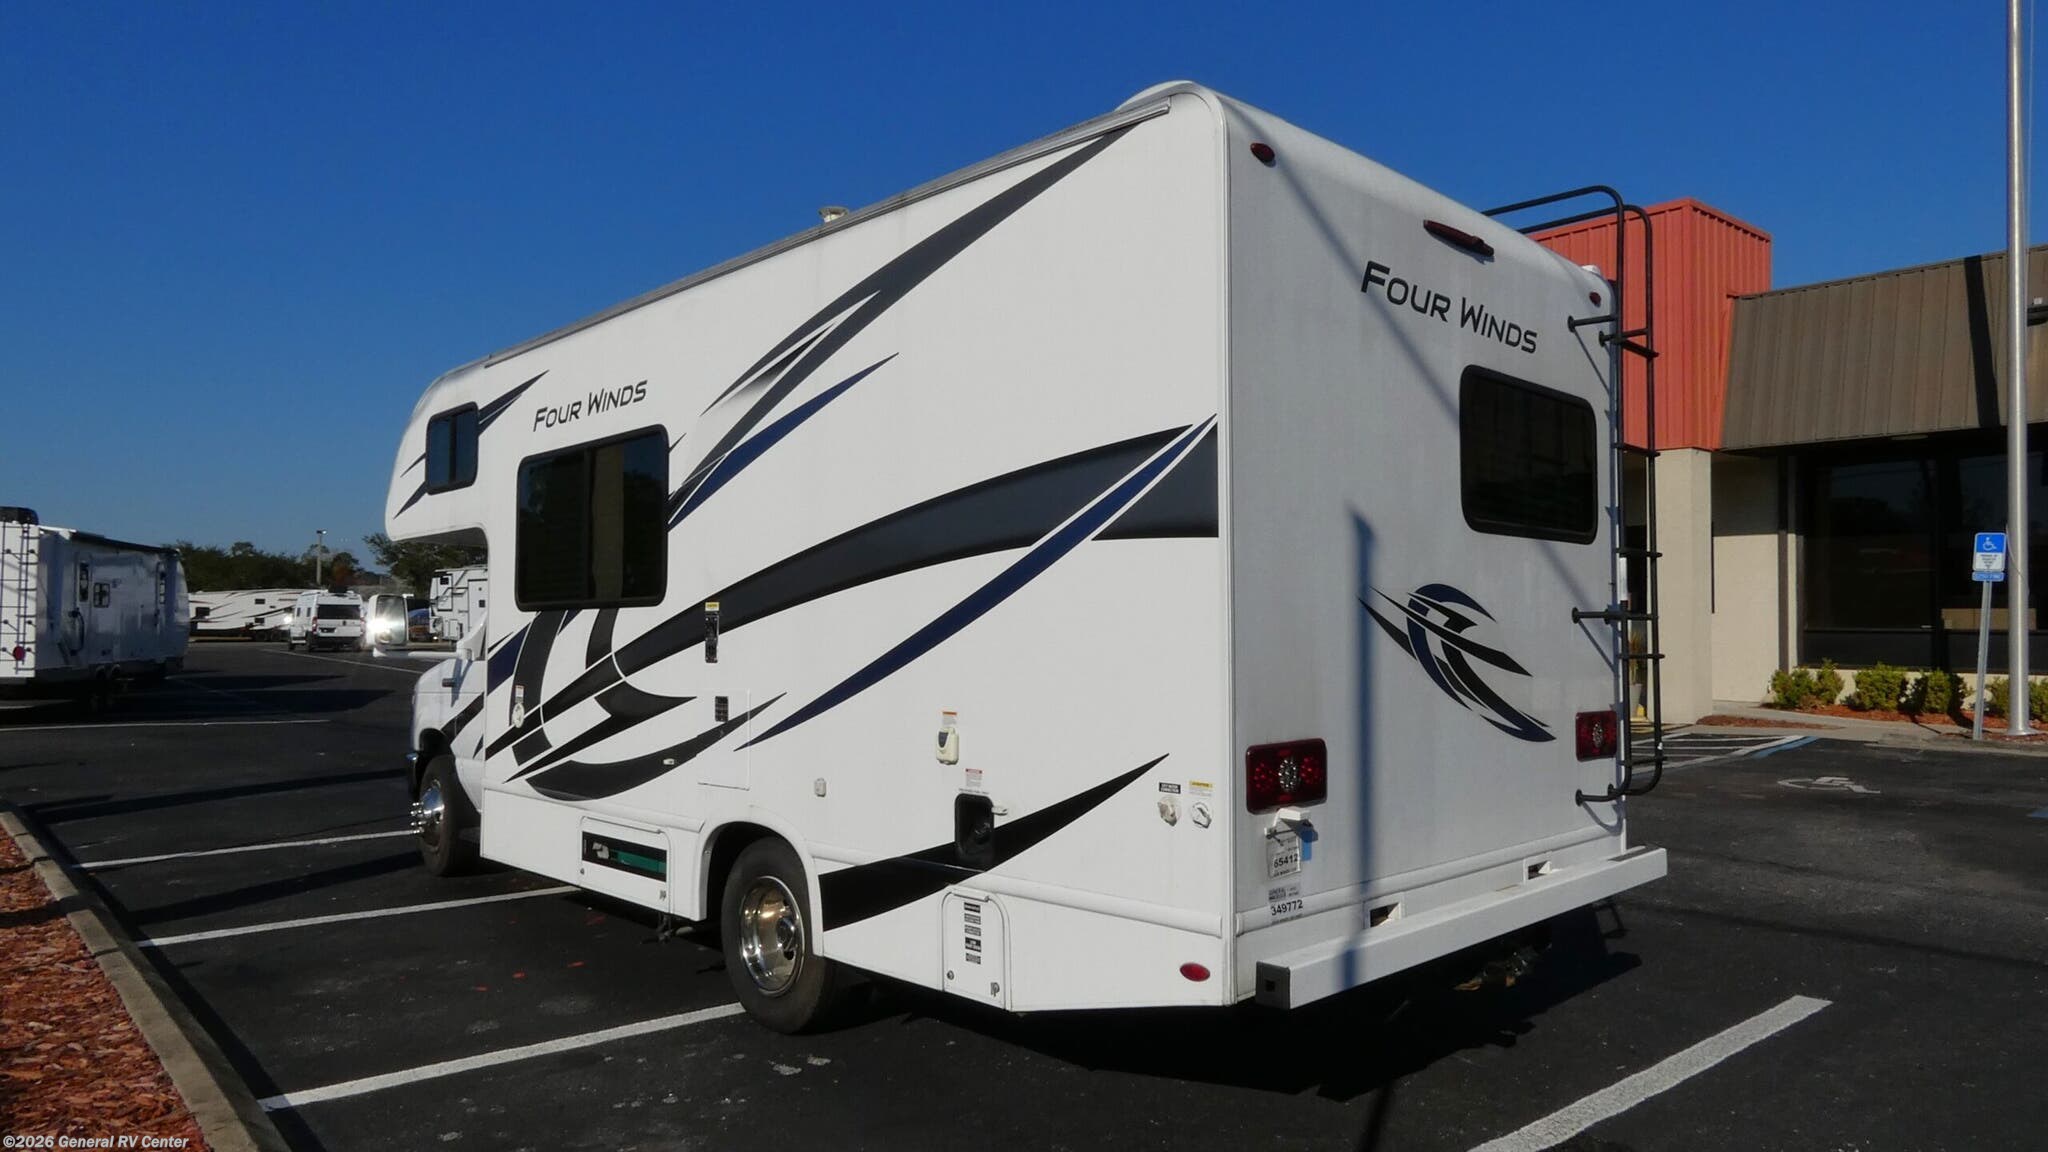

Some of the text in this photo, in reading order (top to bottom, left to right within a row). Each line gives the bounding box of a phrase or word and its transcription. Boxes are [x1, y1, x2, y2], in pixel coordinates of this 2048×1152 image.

[1361, 260, 1537, 354] FOUR WINDS
[533, 380, 648, 432] FOUR WINDS
[1270, 899, 1303, 916] 349772
